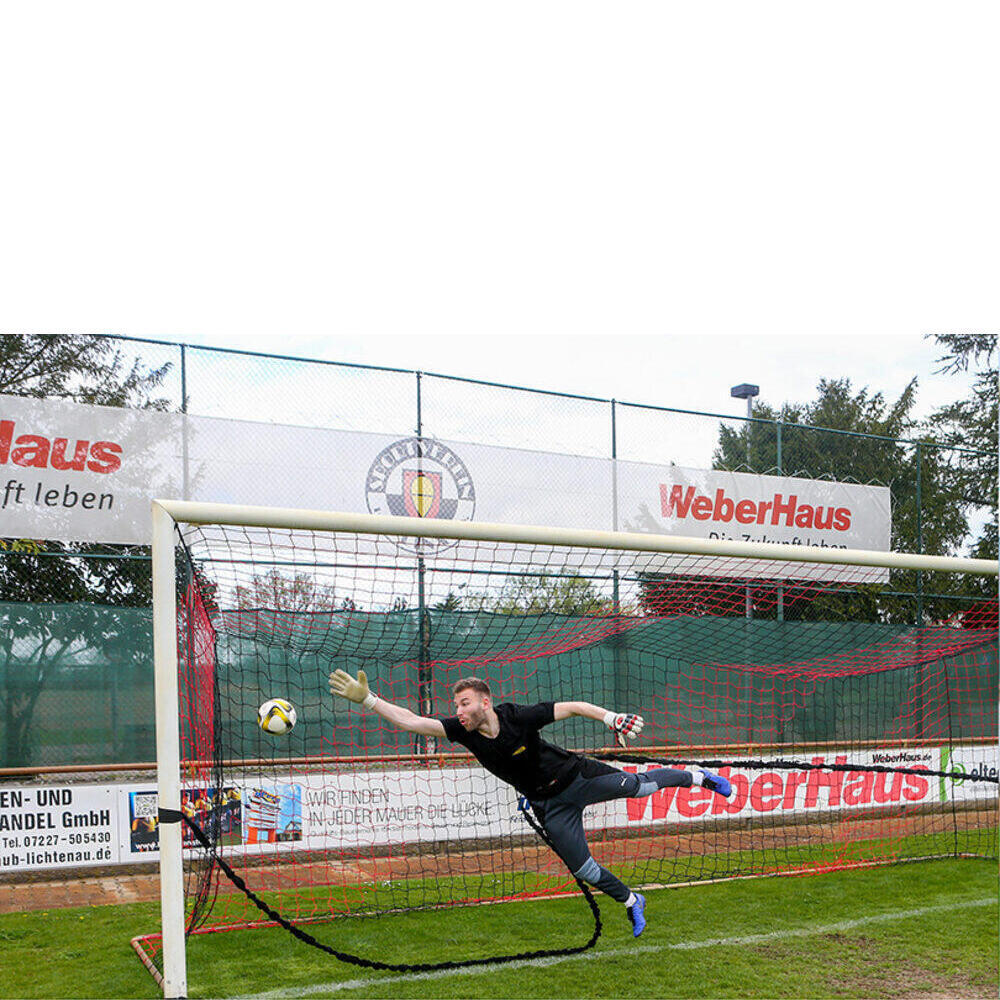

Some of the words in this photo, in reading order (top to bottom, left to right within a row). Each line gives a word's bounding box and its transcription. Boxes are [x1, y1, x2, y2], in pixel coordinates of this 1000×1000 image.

[35, 482, 114, 510] leben
[659, 483, 852, 531] WeberHaus
[872, 753, 932, 763] WeberHaus.de
[0, 790, 31, 808] EN-
[36, 789, 73, 806] UND
[308, 790, 336, 807] WIR
[341, 787, 390, 804] FINDEN
[623, 756, 929, 821] WeberHaus
[0, 812, 56, 831] ANDEL
[62, 809, 110, 828] GmbH
[309, 810, 323, 827] IN
[327, 808, 372, 826] JEDER
[376, 805, 423, 822] MAUER
[427, 803, 447, 819] DIE
[3, 837, 22, 849] Tel.
